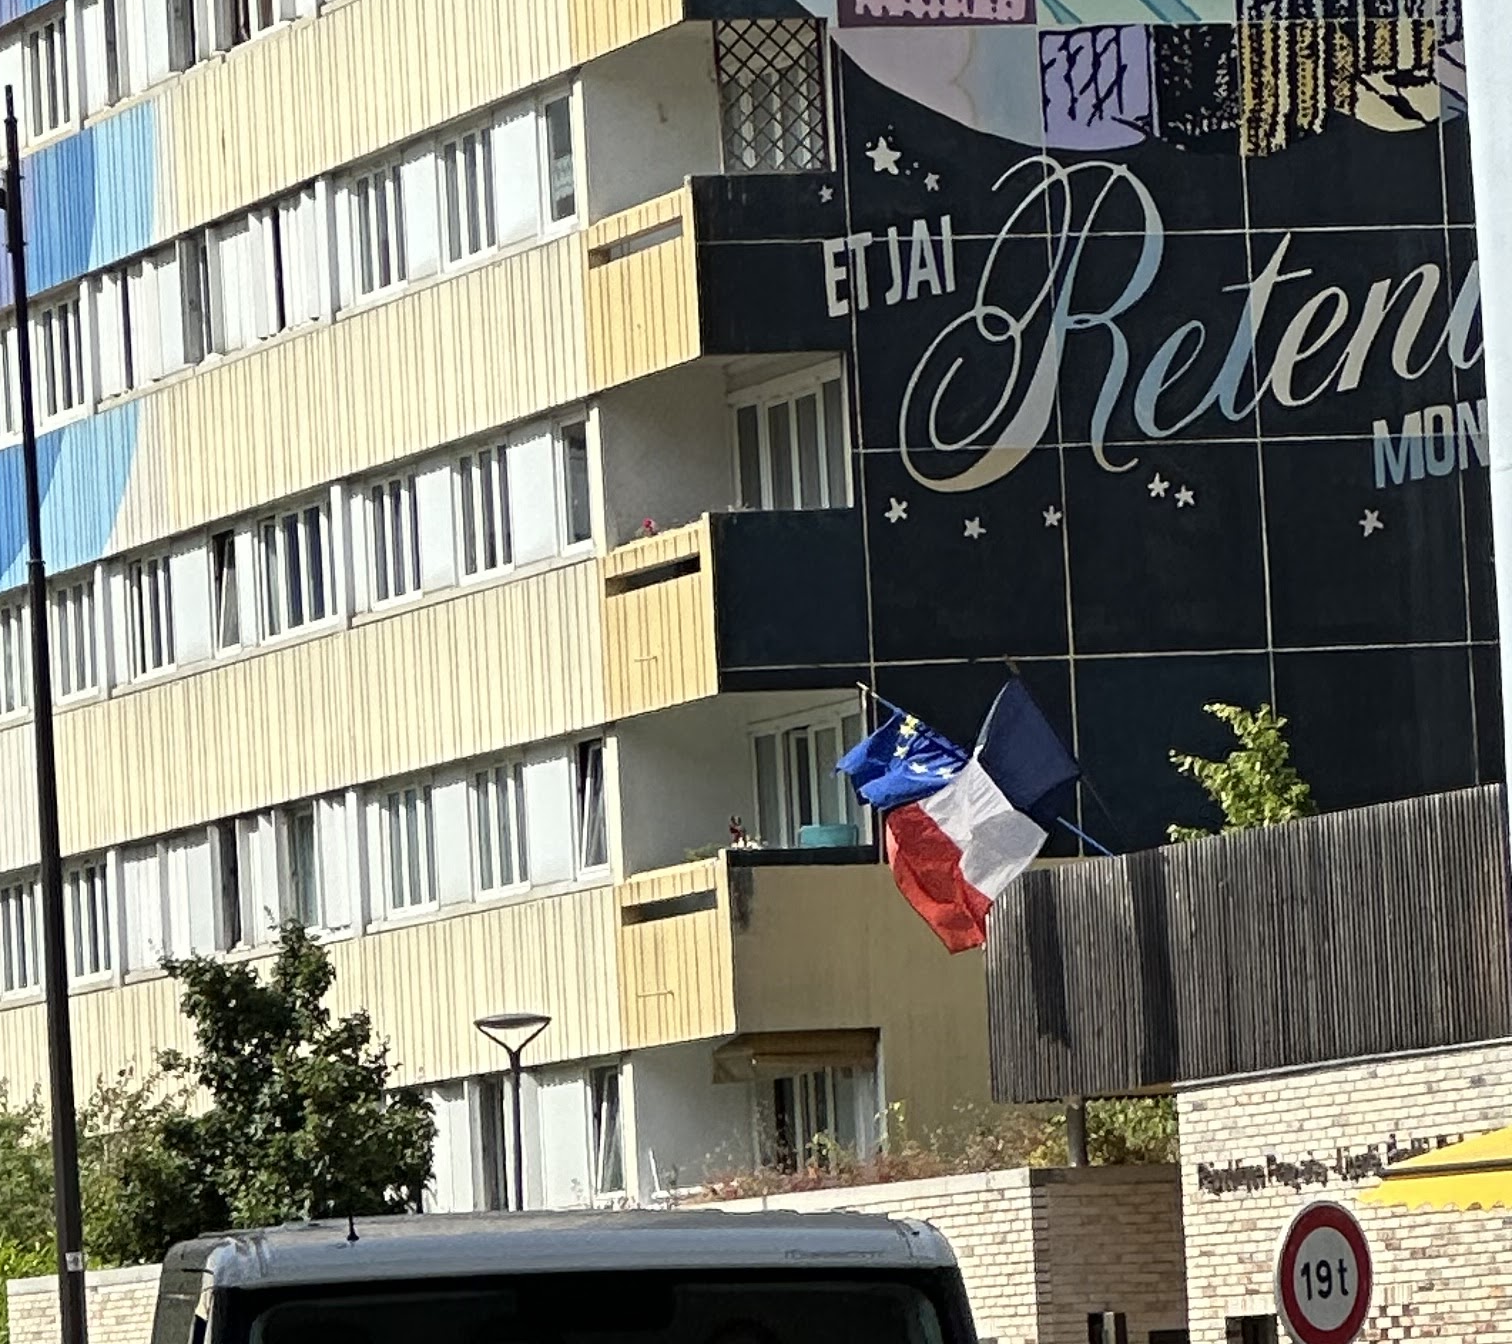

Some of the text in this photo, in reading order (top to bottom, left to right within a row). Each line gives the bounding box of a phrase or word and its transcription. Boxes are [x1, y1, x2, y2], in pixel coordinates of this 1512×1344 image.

[823, 214, 956, 318] ET JAI
[1372, 398, 1490, 489] MON
